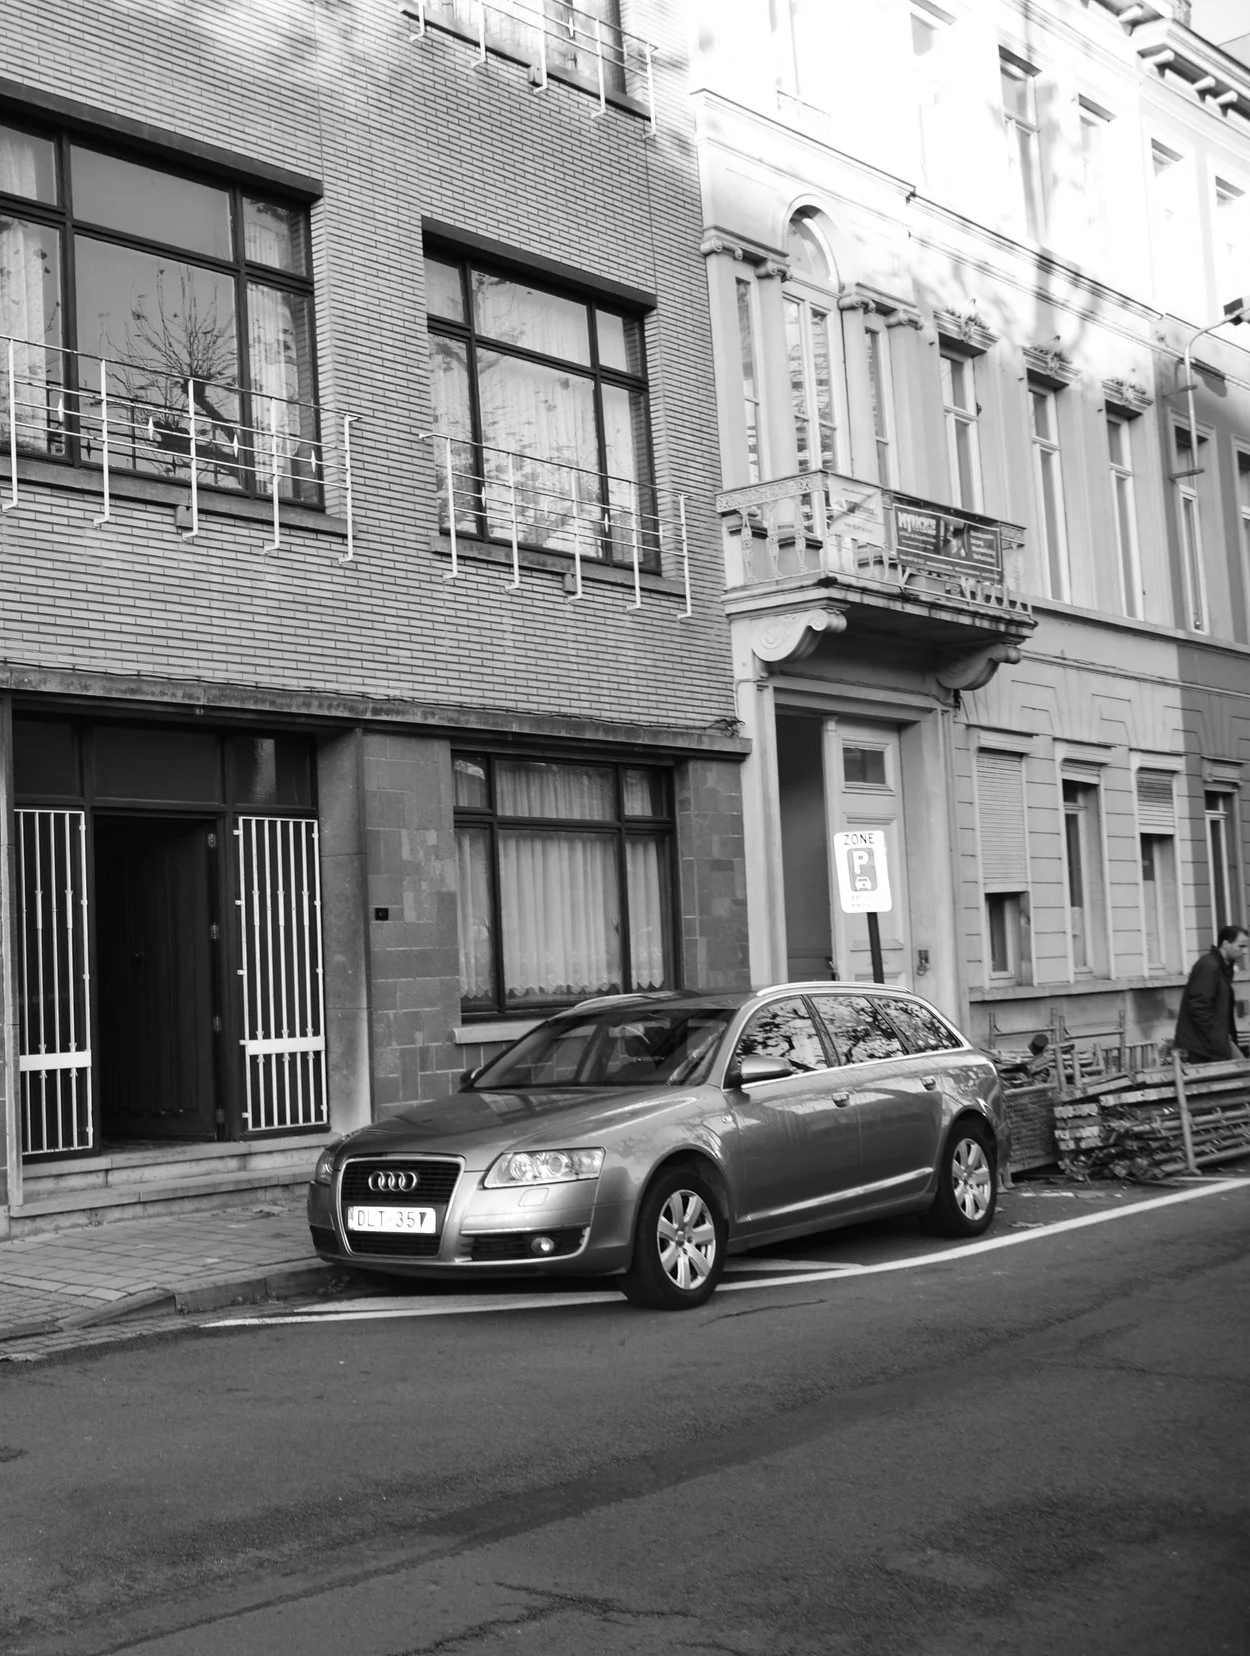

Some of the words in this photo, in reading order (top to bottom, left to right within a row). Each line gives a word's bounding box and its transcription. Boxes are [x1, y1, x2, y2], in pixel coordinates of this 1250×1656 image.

[843, 832, 875, 846] ZONE
[852, 850, 869, 875] P
[357, 1209, 386, 1228] DLT
